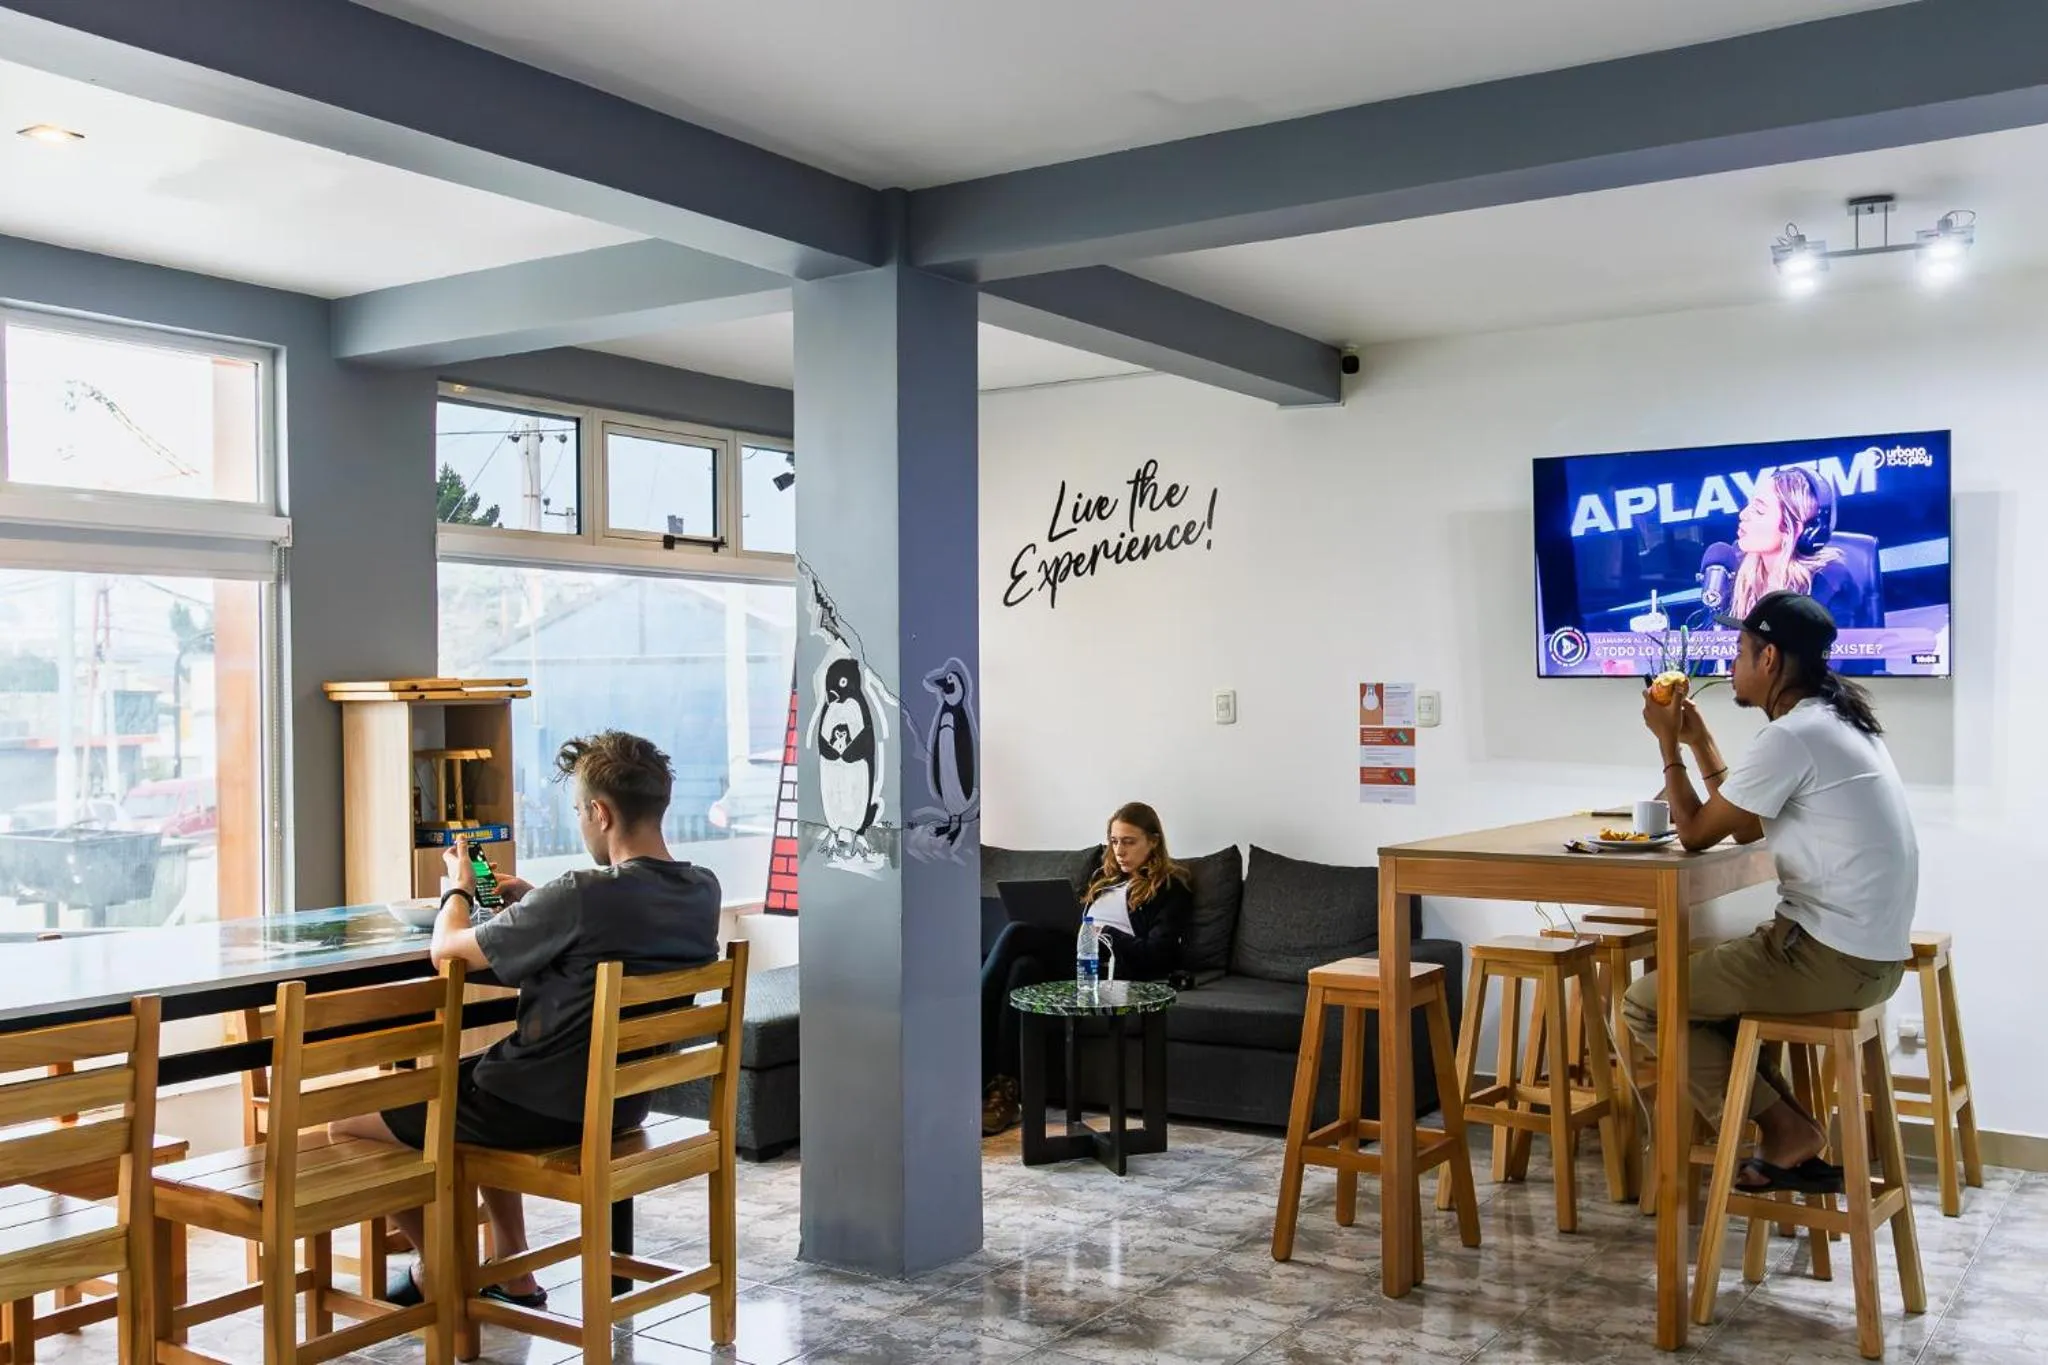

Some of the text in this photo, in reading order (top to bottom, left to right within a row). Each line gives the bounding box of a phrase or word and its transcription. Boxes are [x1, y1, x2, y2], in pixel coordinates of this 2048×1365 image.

[1886, 445, 1927, 458] urbana
[1047, 458, 1190, 542] Live the
[1571, 451, 1877, 537] APLAYM
[1002, 487, 1219, 609] Experience!
[1639, 645, 1655, 656] LO
